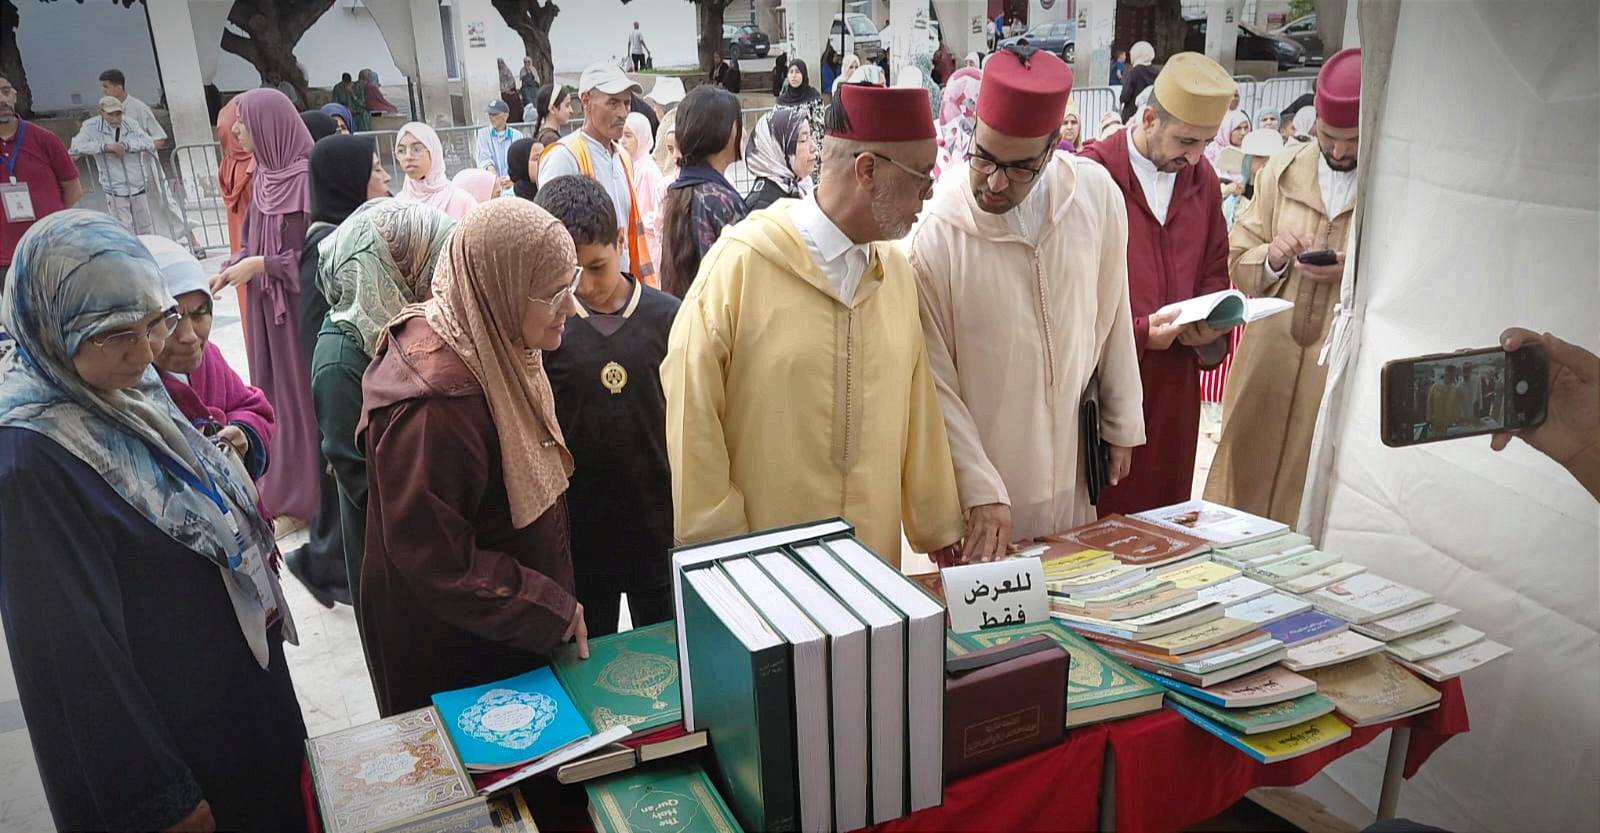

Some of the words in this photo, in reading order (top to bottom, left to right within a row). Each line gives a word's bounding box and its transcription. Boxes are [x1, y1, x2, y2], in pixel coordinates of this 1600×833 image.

[964, 572, 1031, 605] للعرض
[979, 604, 1026, 629] فقط
[651, 808, 678, 820] Holy
[659, 817, 679, 827] The
